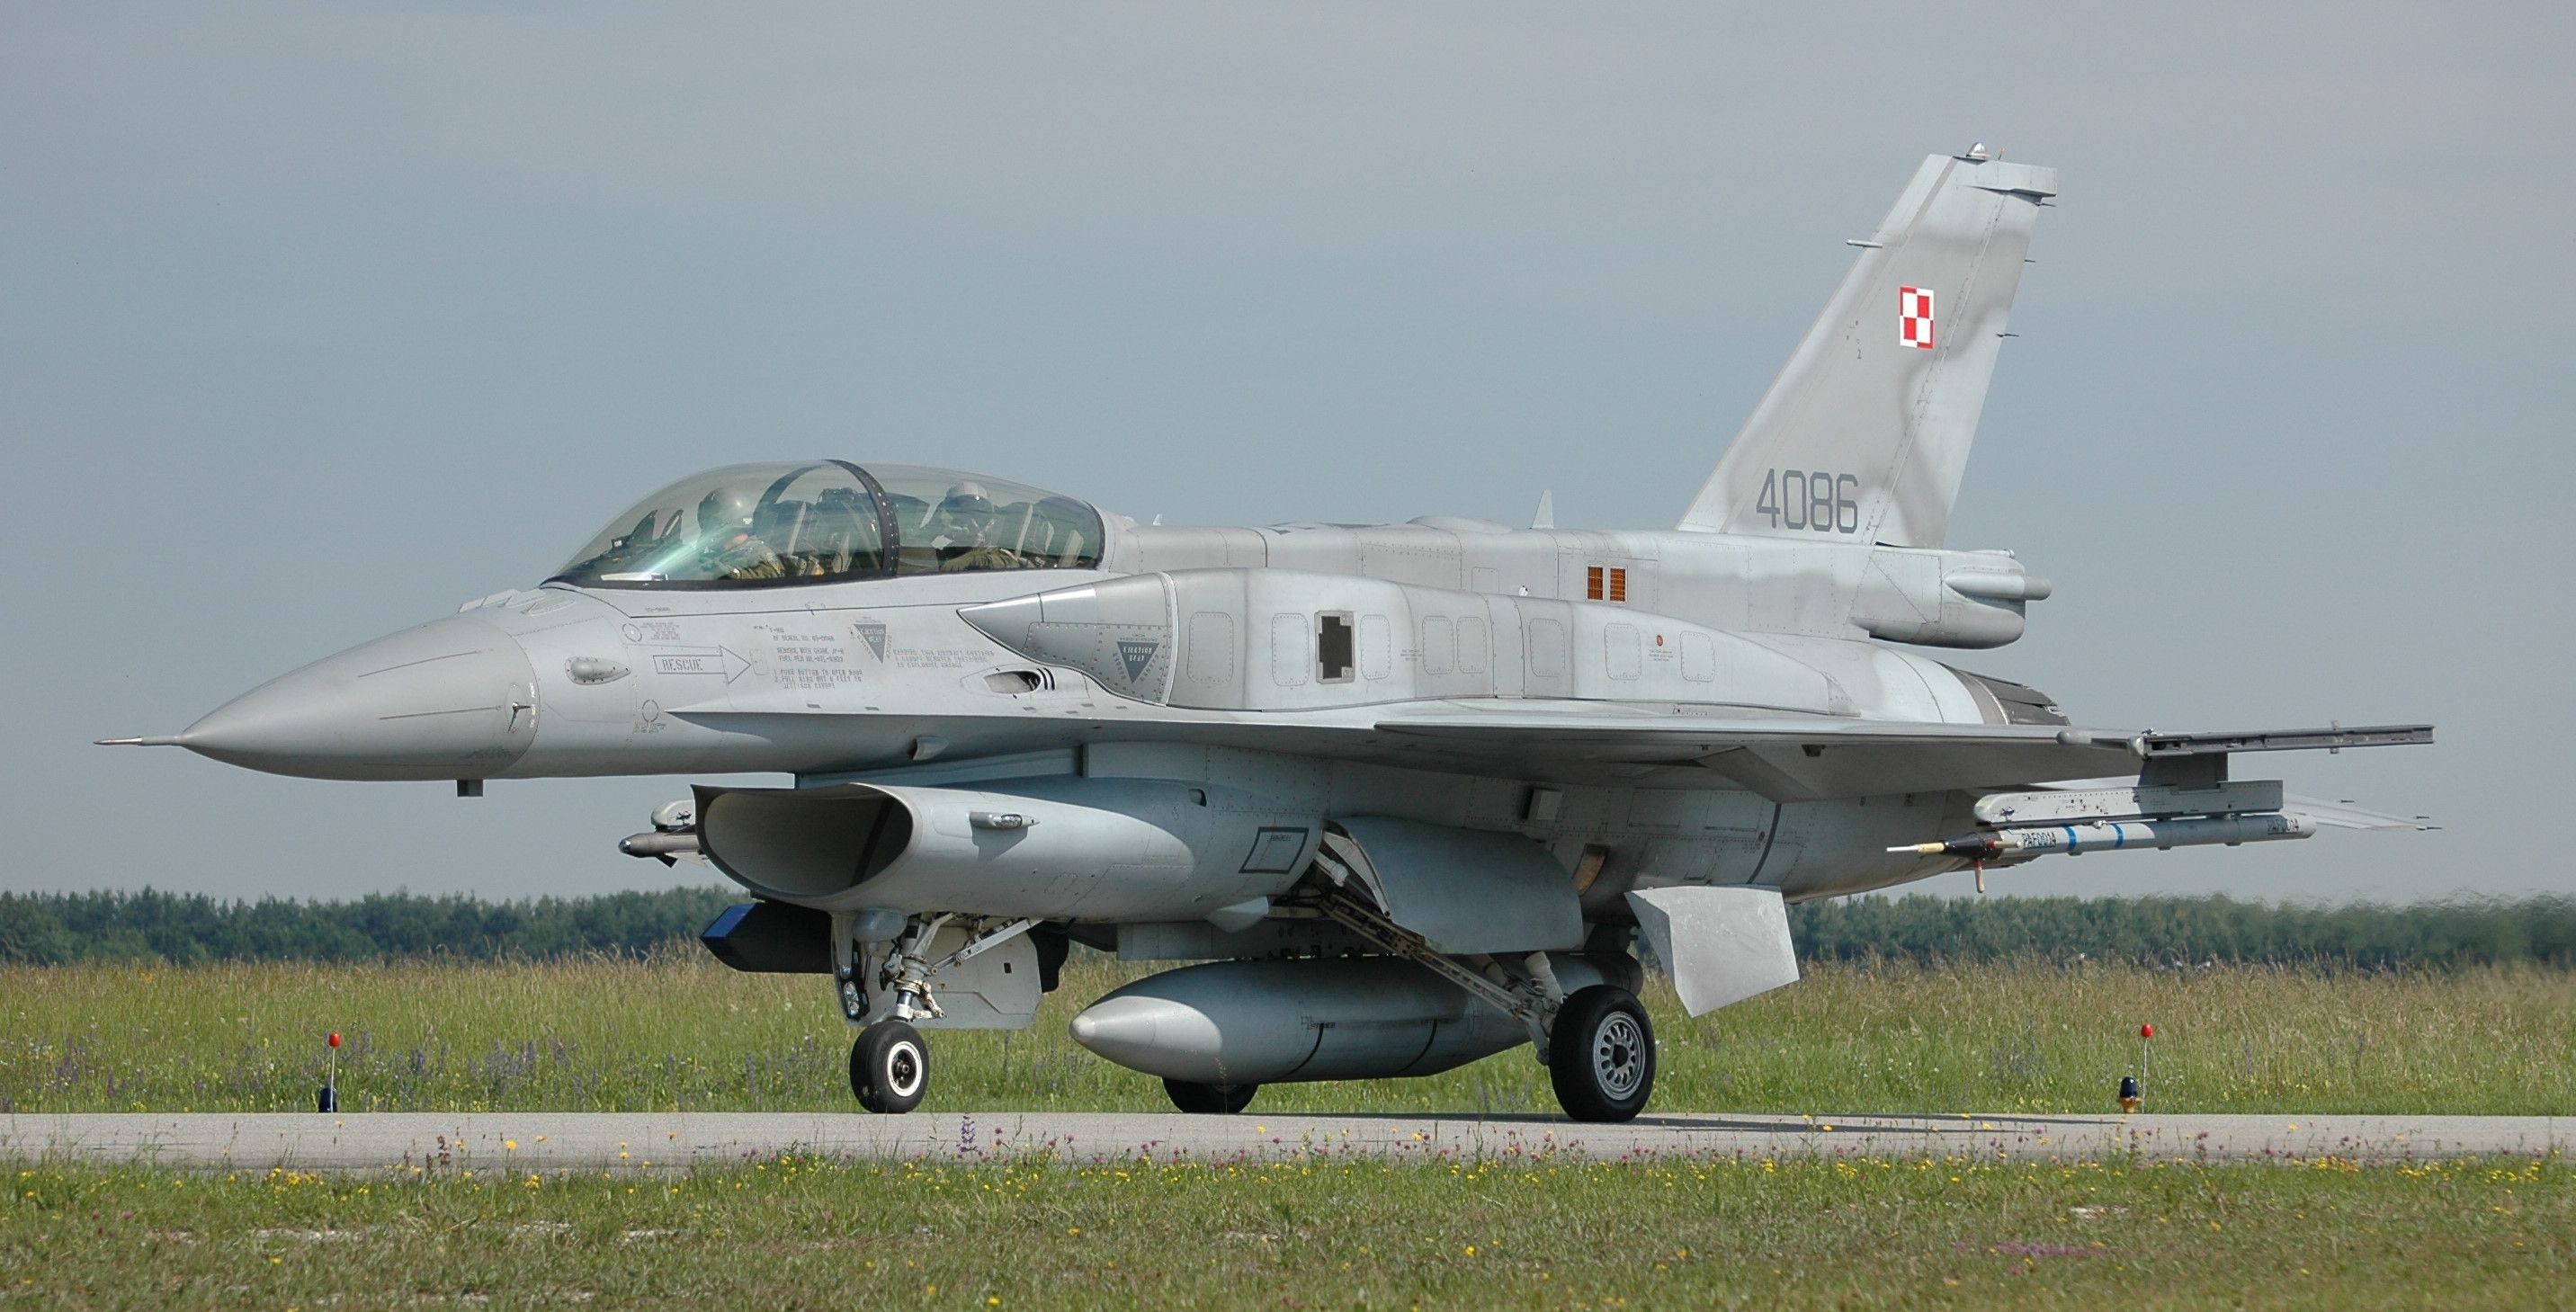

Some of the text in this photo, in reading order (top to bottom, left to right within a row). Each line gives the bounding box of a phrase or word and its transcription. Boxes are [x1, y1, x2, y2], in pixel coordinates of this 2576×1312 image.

[1756, 468, 1858, 534] 4086
[661, 658, 703, 671] RESCUE
[2022, 832, 2057, 847] PAF0014
